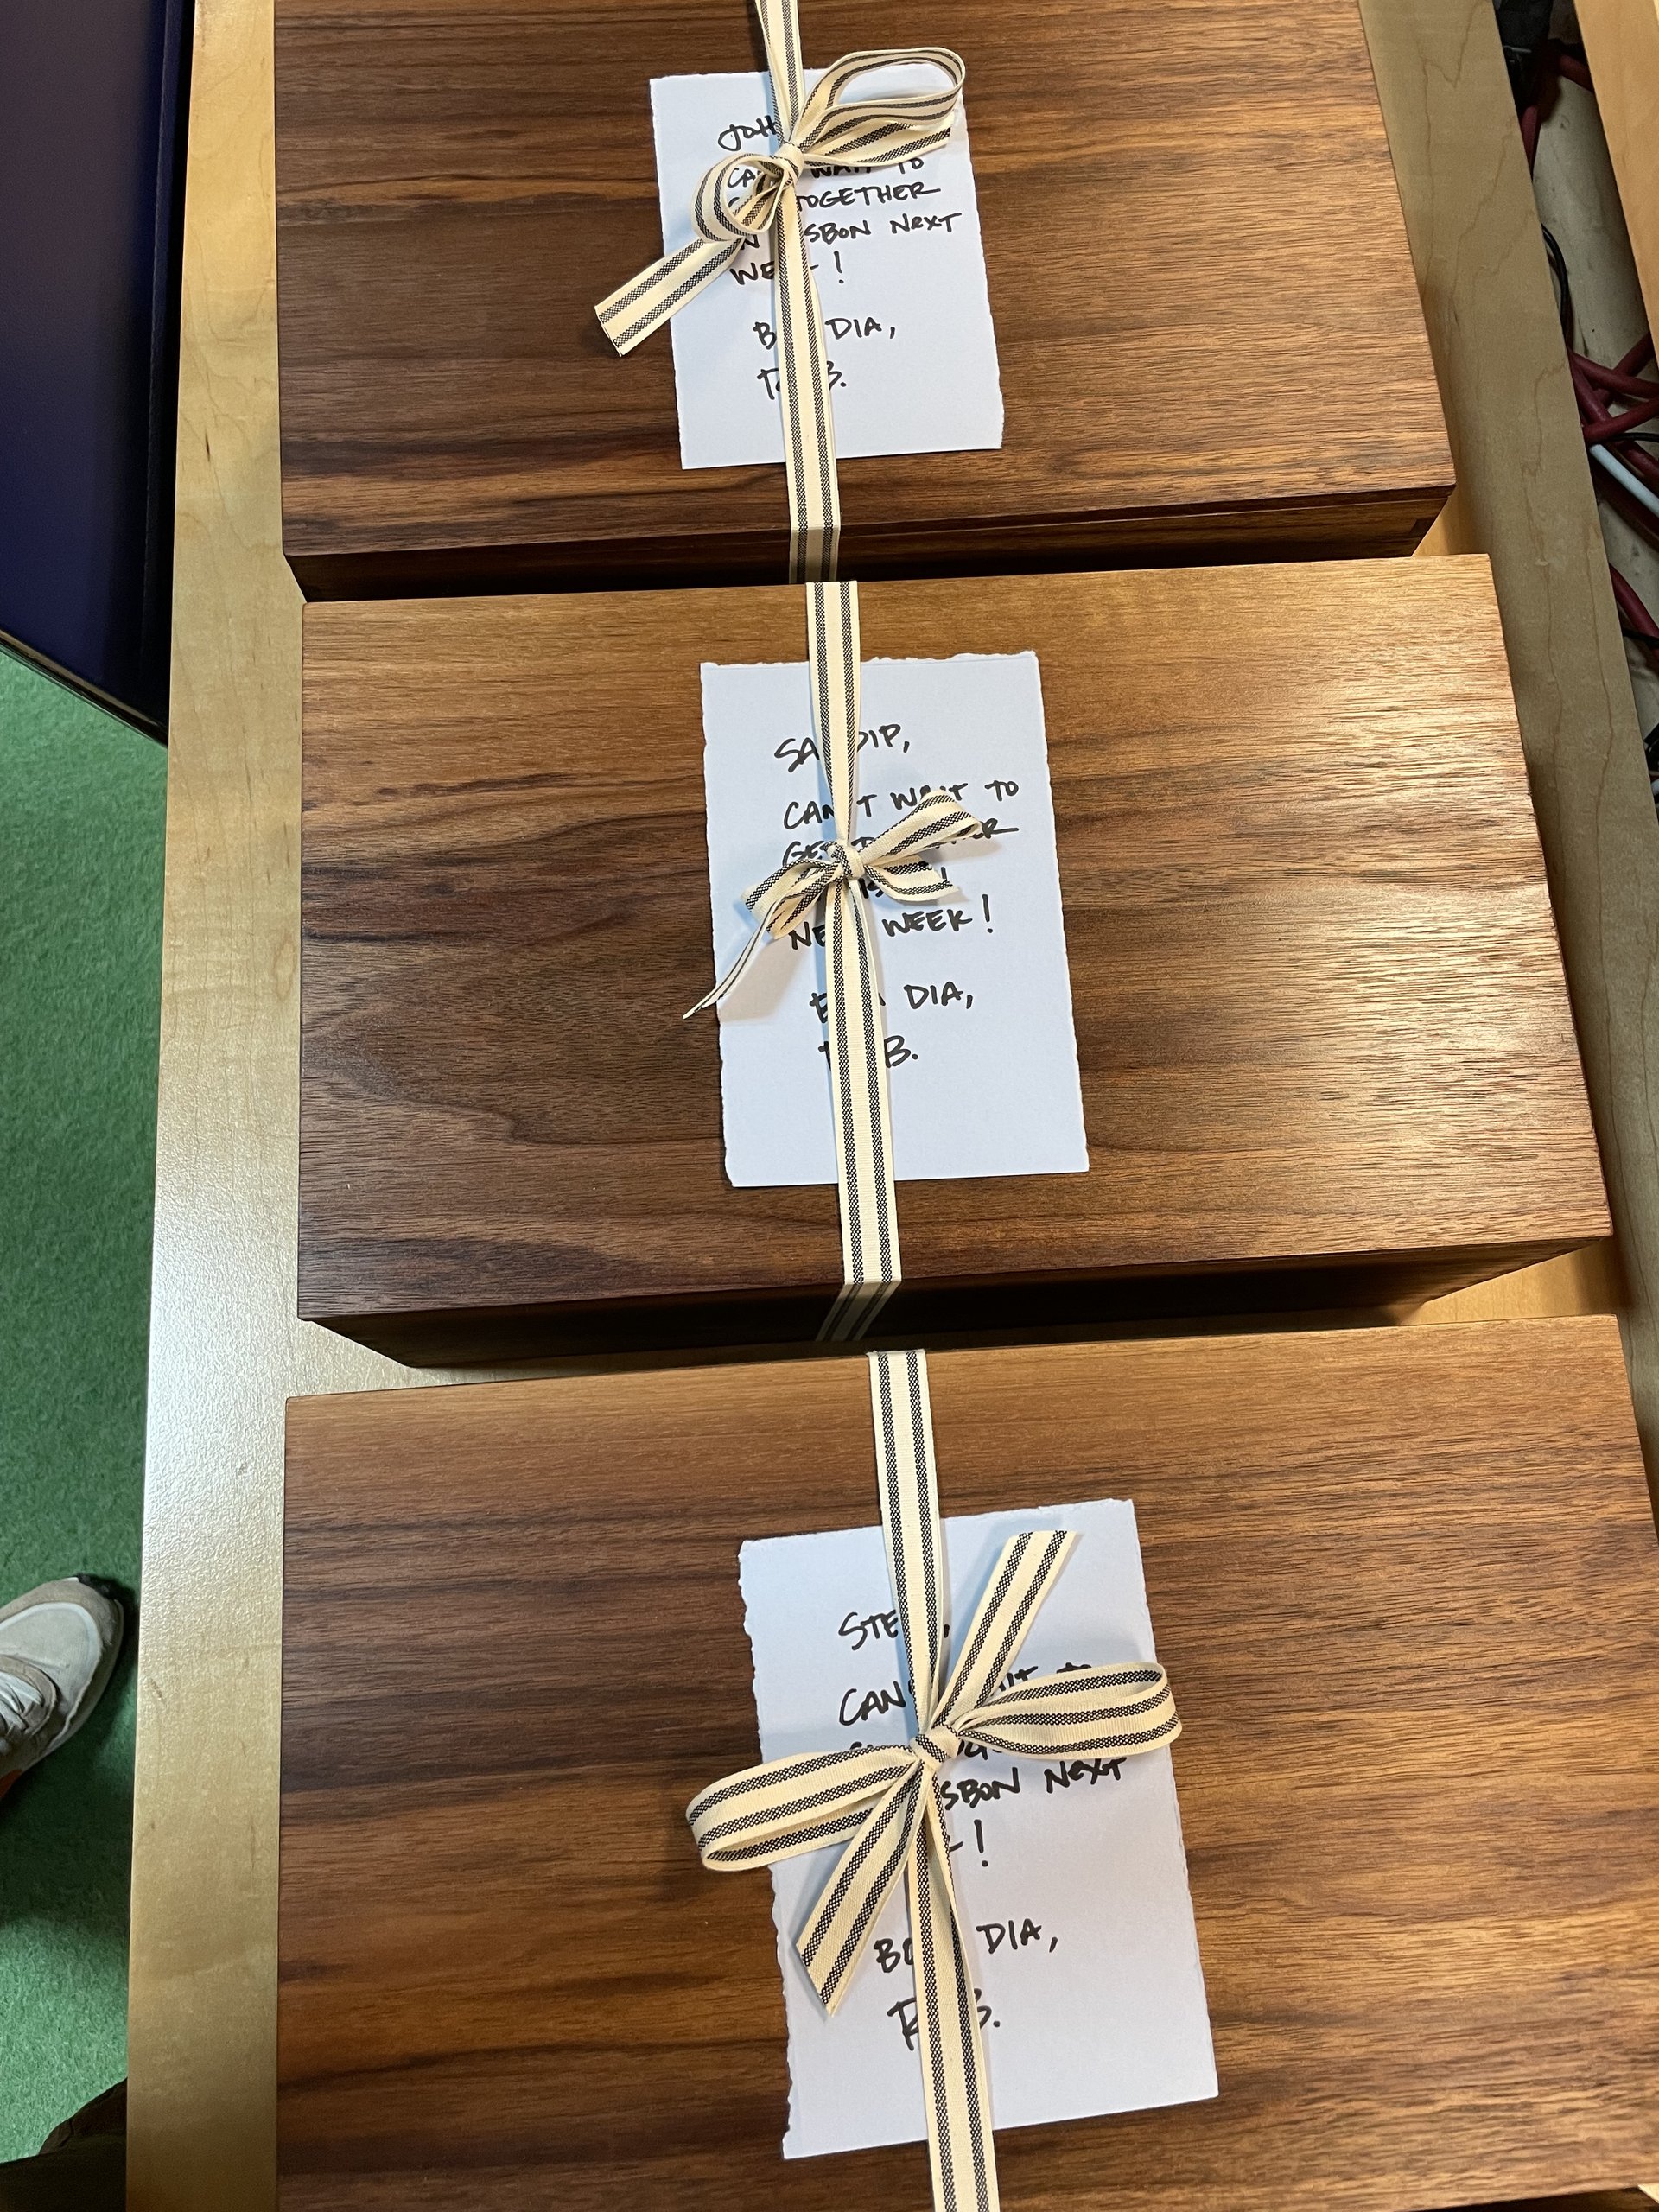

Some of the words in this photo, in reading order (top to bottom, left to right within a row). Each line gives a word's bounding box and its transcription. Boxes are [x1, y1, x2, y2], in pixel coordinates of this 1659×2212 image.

[824, 316, 896, 340] DIA,
[984, 779, 1020, 802] TO
[903, 981, 974, 1010] DIA,
[975, 1918, 1058, 1955] DIA,
